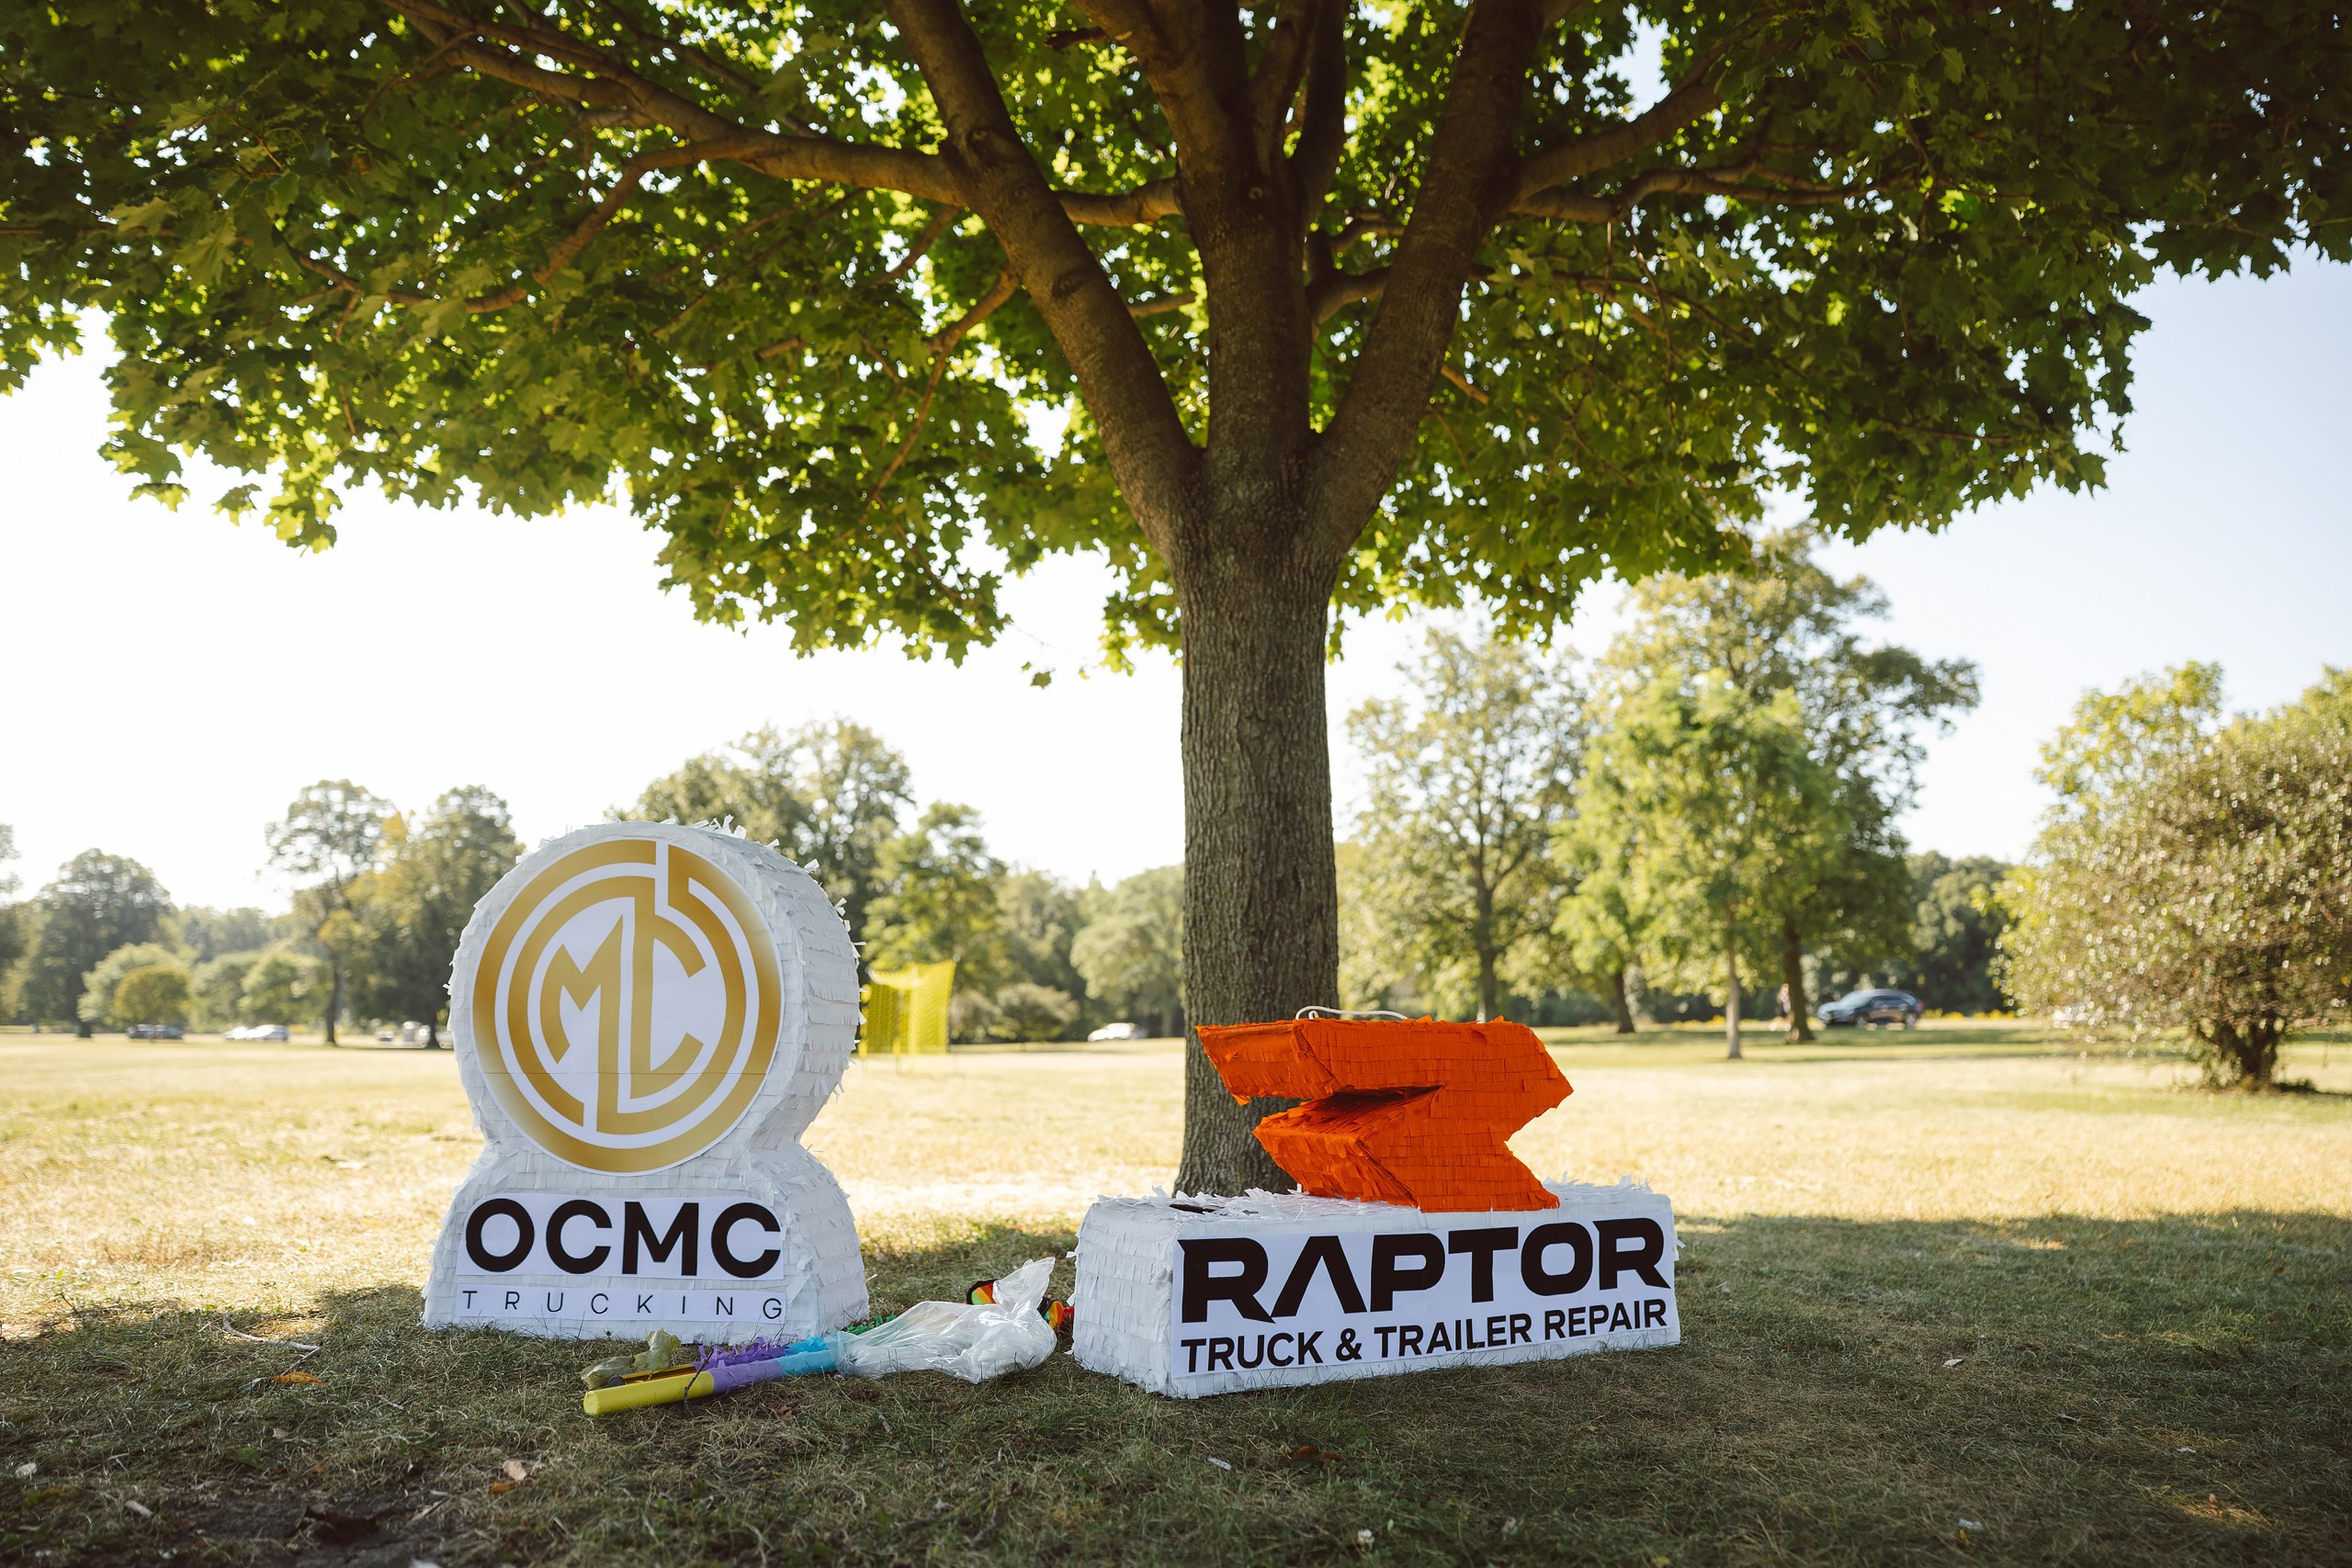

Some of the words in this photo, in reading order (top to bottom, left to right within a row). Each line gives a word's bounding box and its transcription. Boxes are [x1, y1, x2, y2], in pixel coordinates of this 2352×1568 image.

[465, 1198, 782, 1278] OCMC
[1177, 1217, 1671, 1325] RAPTOR
[462, 1290, 783, 1320] TRUCKING
[1181, 1330, 1324, 1373] TRUCK
[1335, 1327, 1363, 1362] &
[1374, 1313, 1532, 1359] TRAILER
[1544, 1298, 1668, 1341] REPAIR
